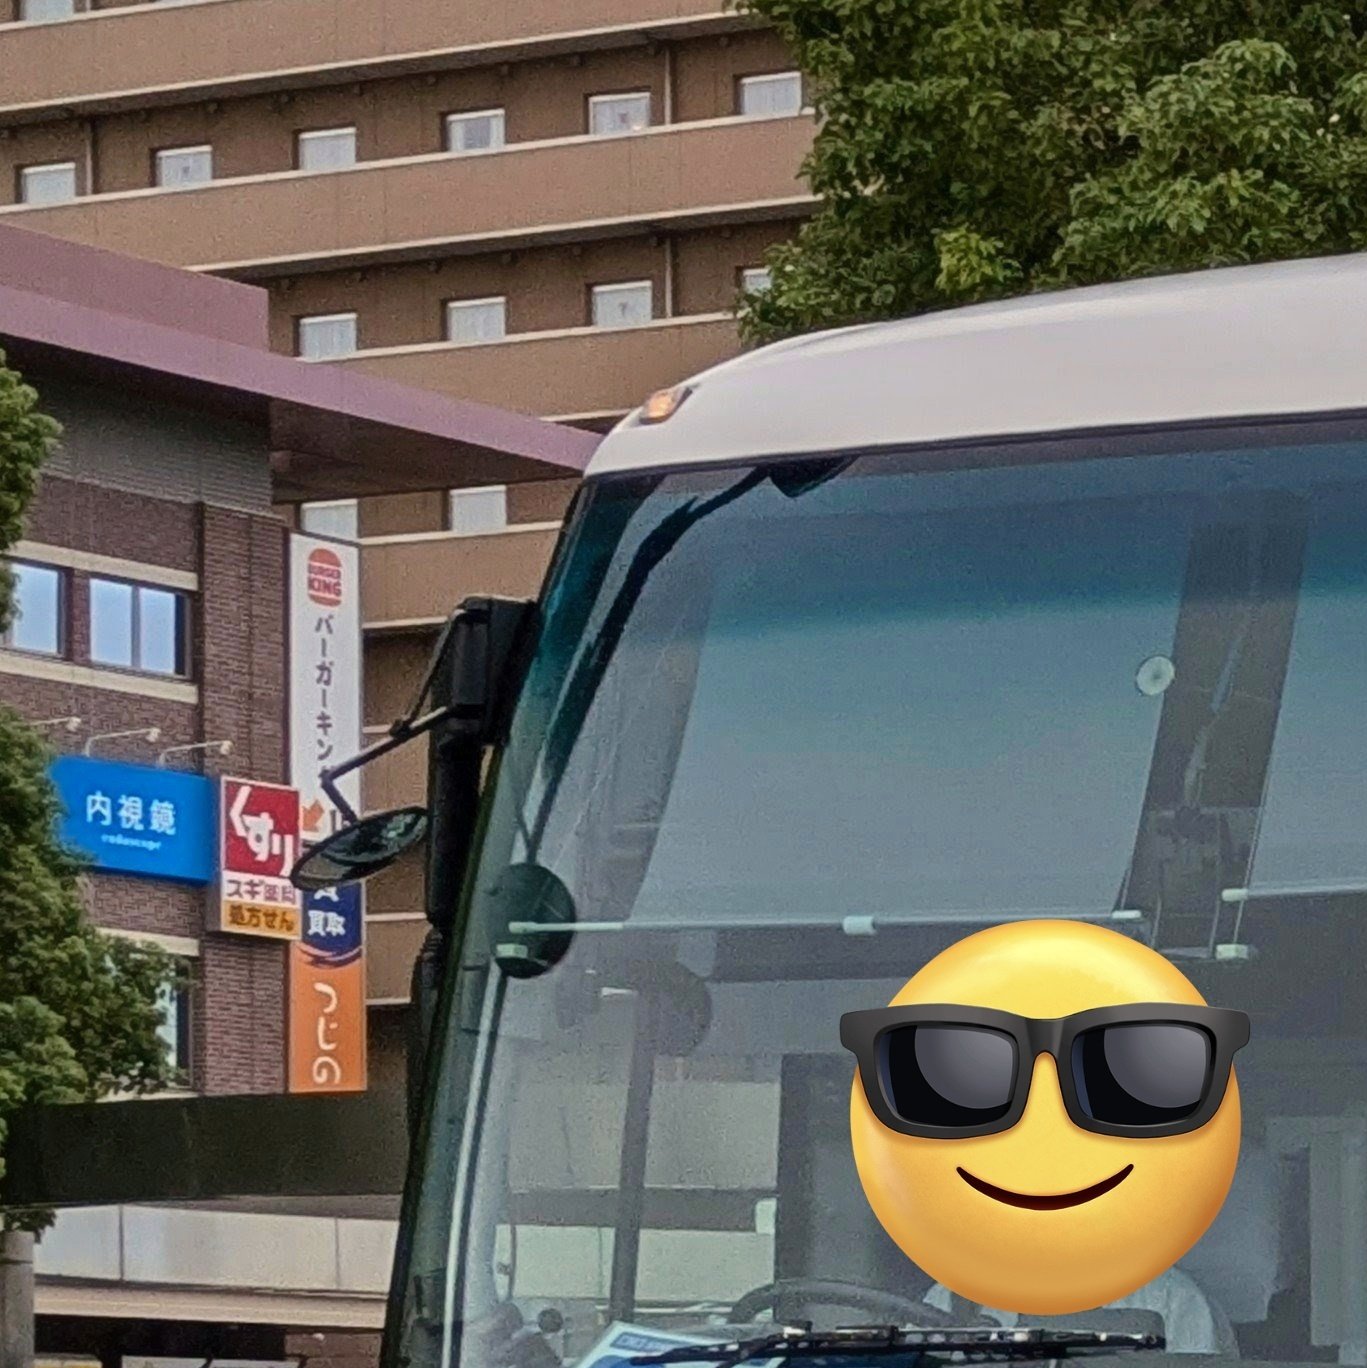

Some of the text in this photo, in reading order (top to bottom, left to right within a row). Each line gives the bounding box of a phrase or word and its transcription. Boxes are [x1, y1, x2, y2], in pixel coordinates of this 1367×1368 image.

[85, 790, 176, 835] 内視鏡
[229, 785, 294, 878] くすり
